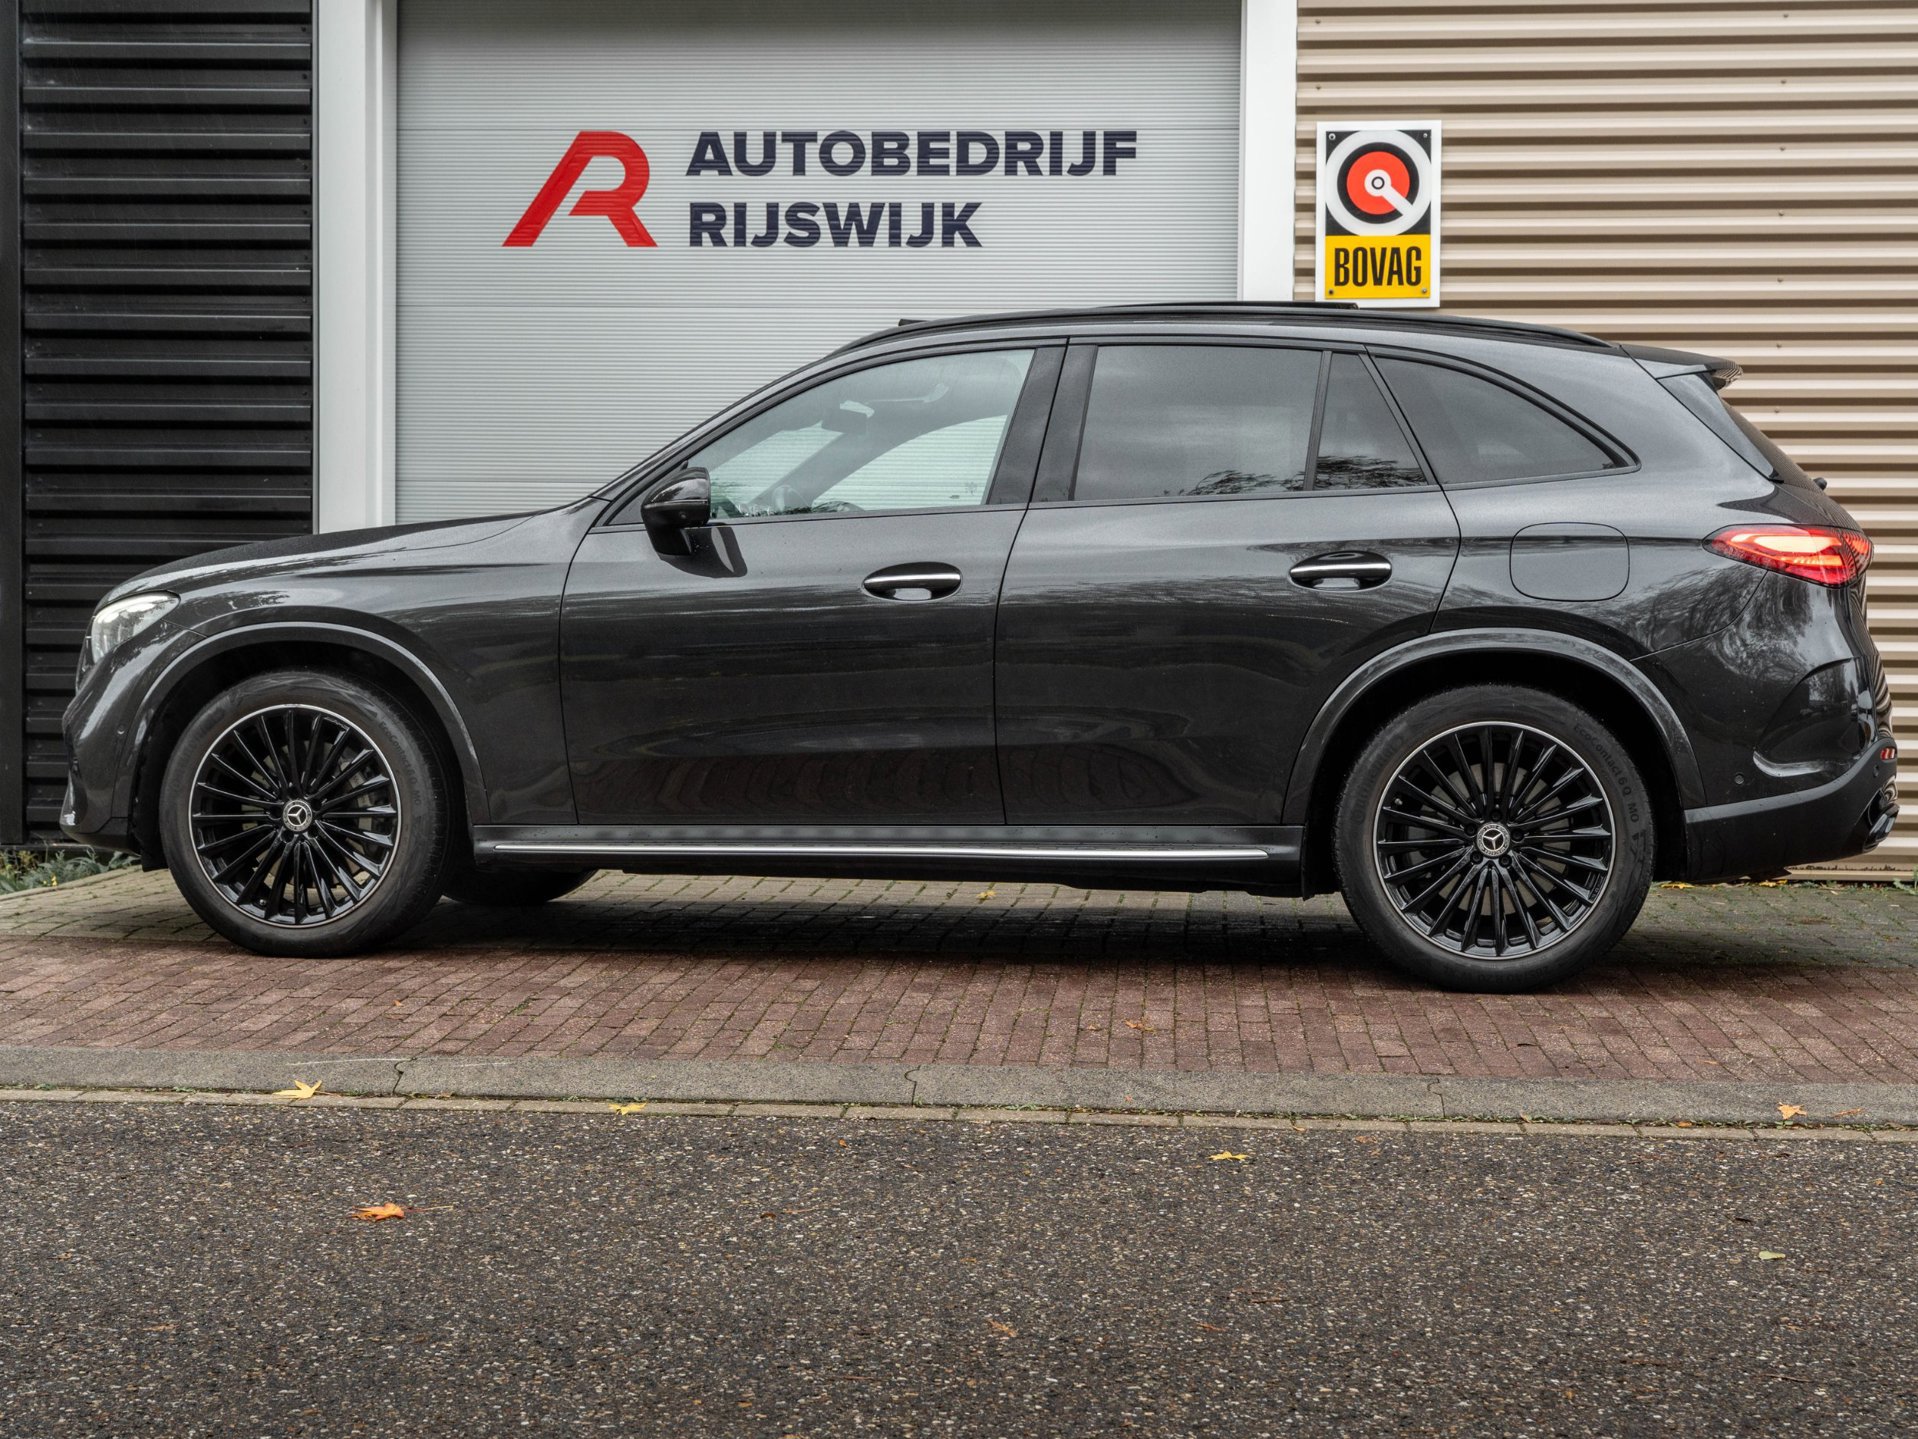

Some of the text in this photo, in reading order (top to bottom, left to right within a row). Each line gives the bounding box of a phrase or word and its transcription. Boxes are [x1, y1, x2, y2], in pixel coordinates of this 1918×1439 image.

[686, 130, 1137, 177] AUTOBEDRIJF
[690, 202, 982, 248] RIJSWIJK
[1334, 246, 1422, 287] BOVAG
